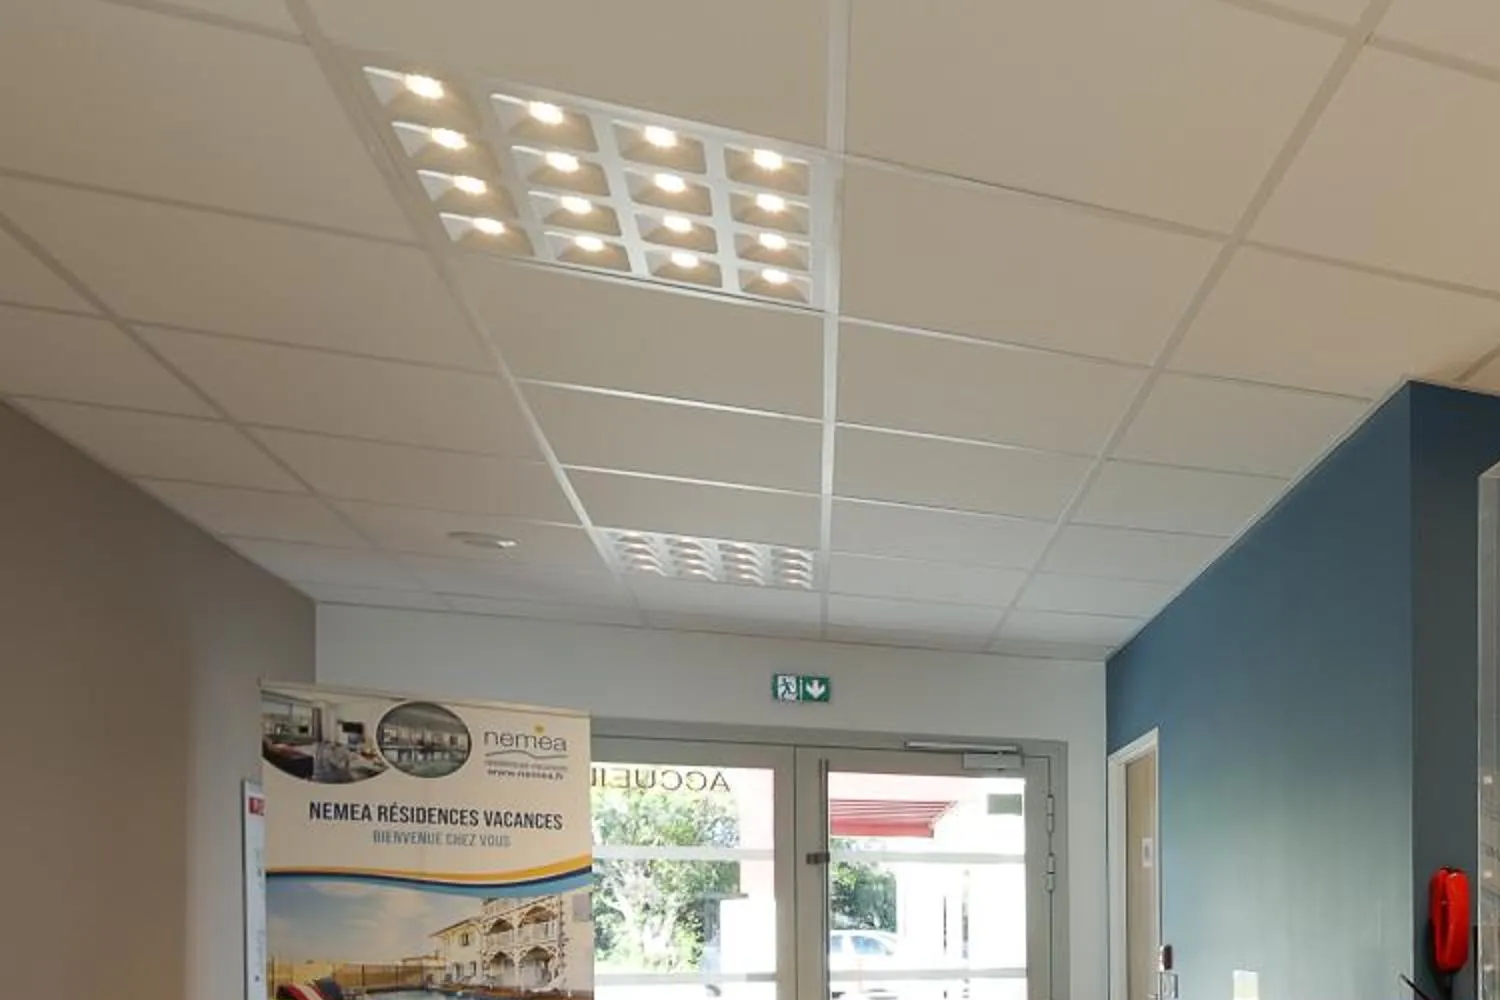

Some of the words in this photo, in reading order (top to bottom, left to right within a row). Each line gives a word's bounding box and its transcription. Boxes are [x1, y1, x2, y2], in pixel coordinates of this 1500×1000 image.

[483, 729, 568, 752] nemea
[309, 801, 373, 823] NEMEA
[377, 802, 480, 828] RÉSIDENCES
[483, 808, 564, 832] VACANCES
[373, 829, 441, 846] BIENVENUE
[445, 832, 477, 847] CHEZ
[479, 834, 512, 848] VOUS
